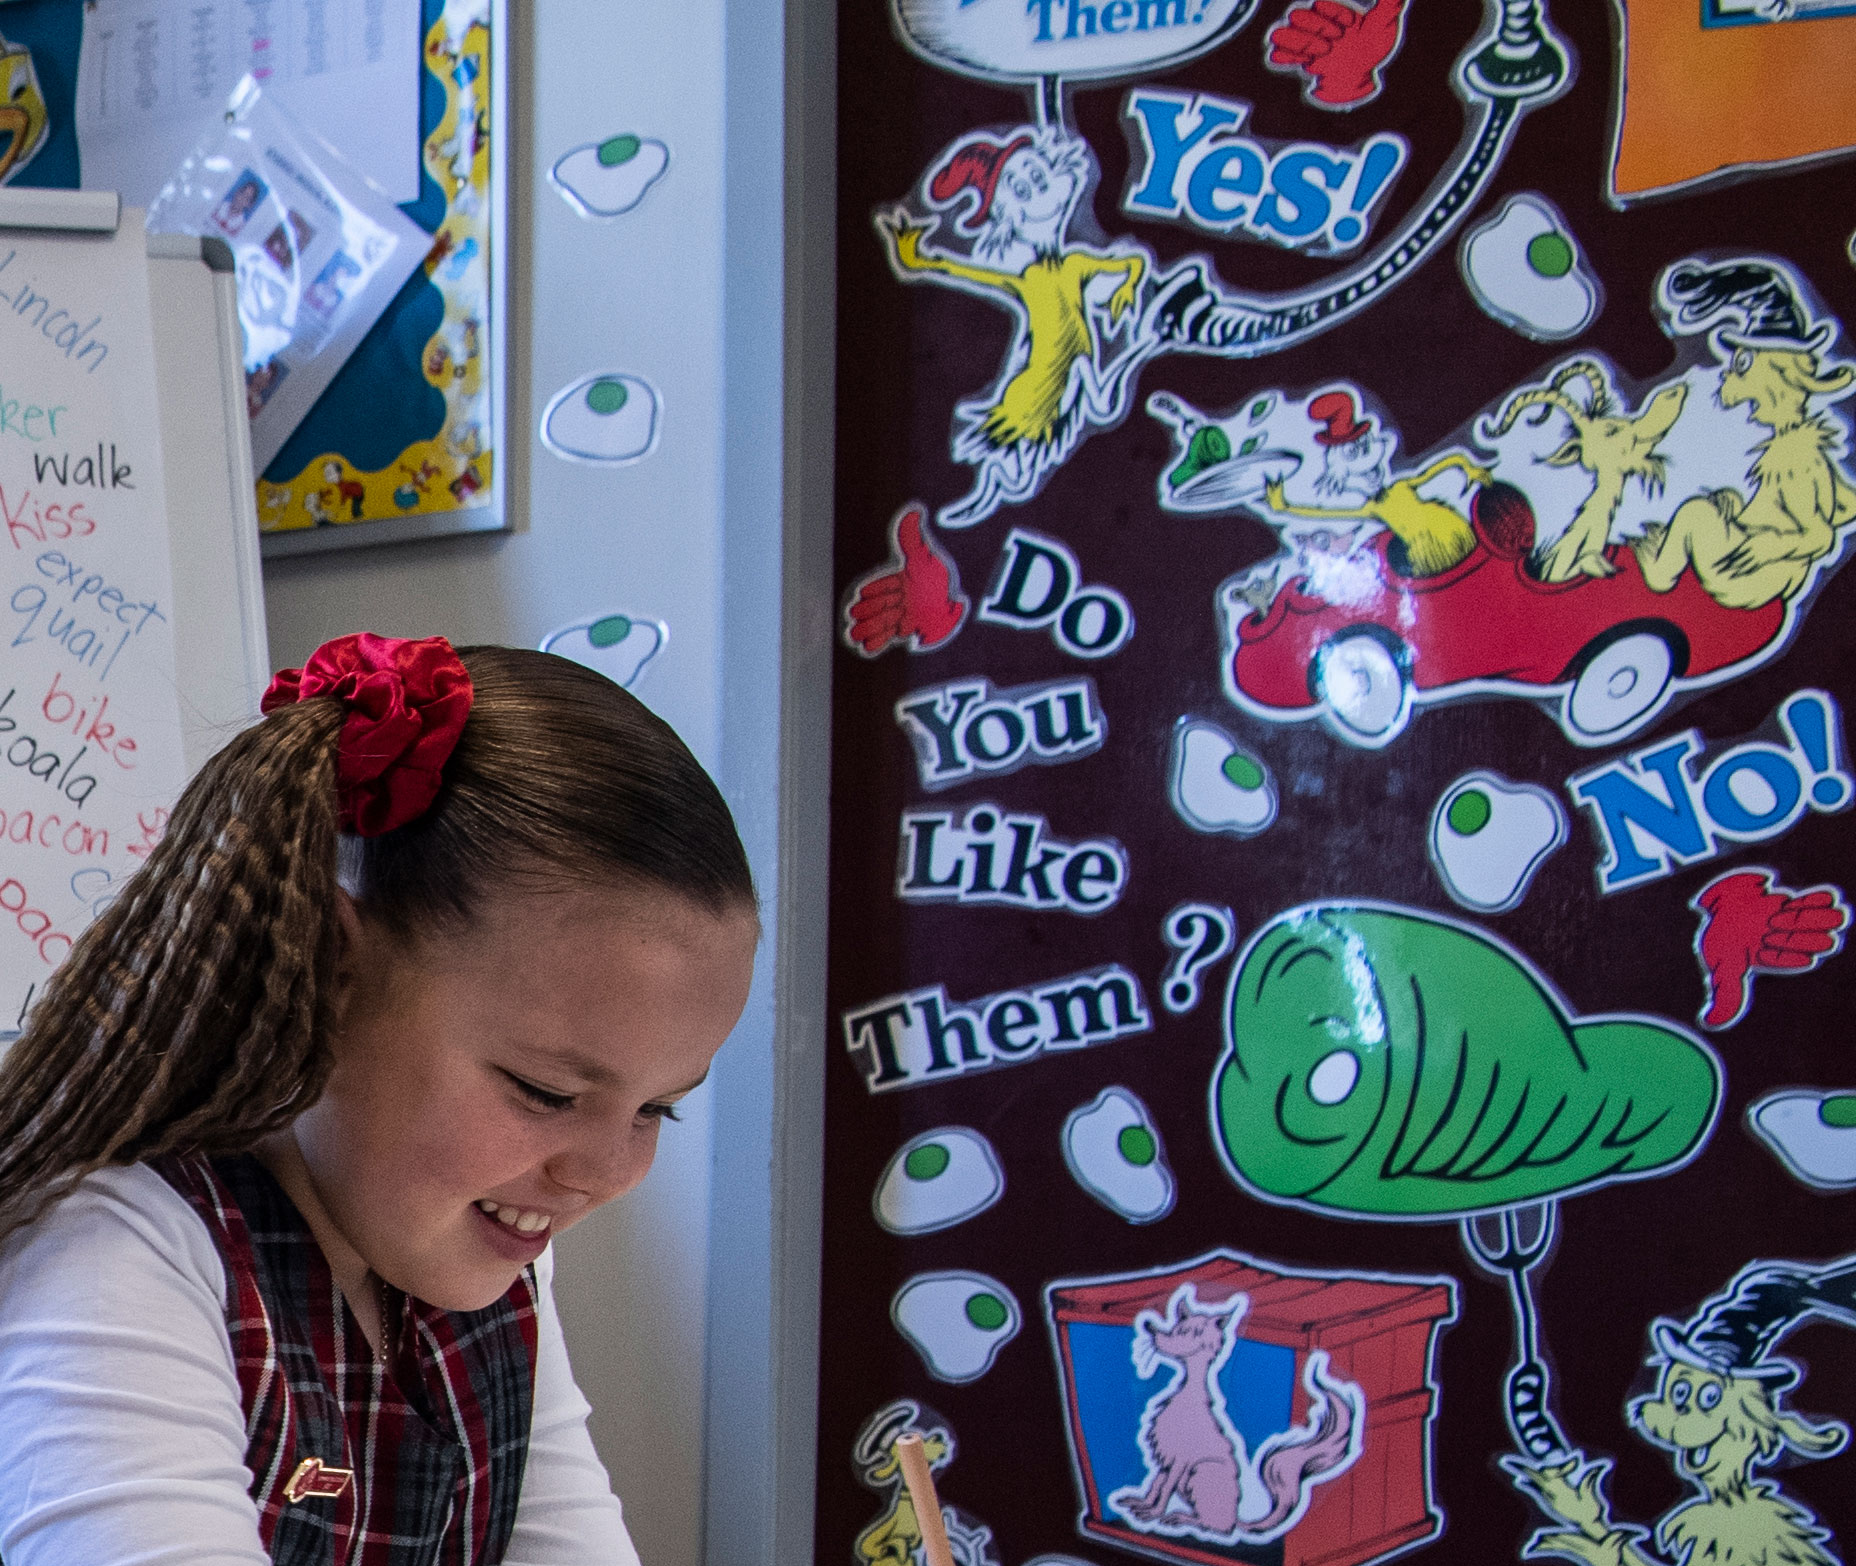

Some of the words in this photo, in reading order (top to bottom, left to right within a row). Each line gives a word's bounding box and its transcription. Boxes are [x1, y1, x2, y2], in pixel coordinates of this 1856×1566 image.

[1133, 97, 1400, 243] Yes!
[34, 442, 137, 490] walk
[10, 584, 131, 682] quail
[35, 548, 167, 635] expect
[988, 540, 1127, 650] Do
[42, 673, 138, 770] bike
[900, 684, 1098, 779] You
[1579, 698, 1848, 885] No!
[905, 812, 1121, 908] Like
